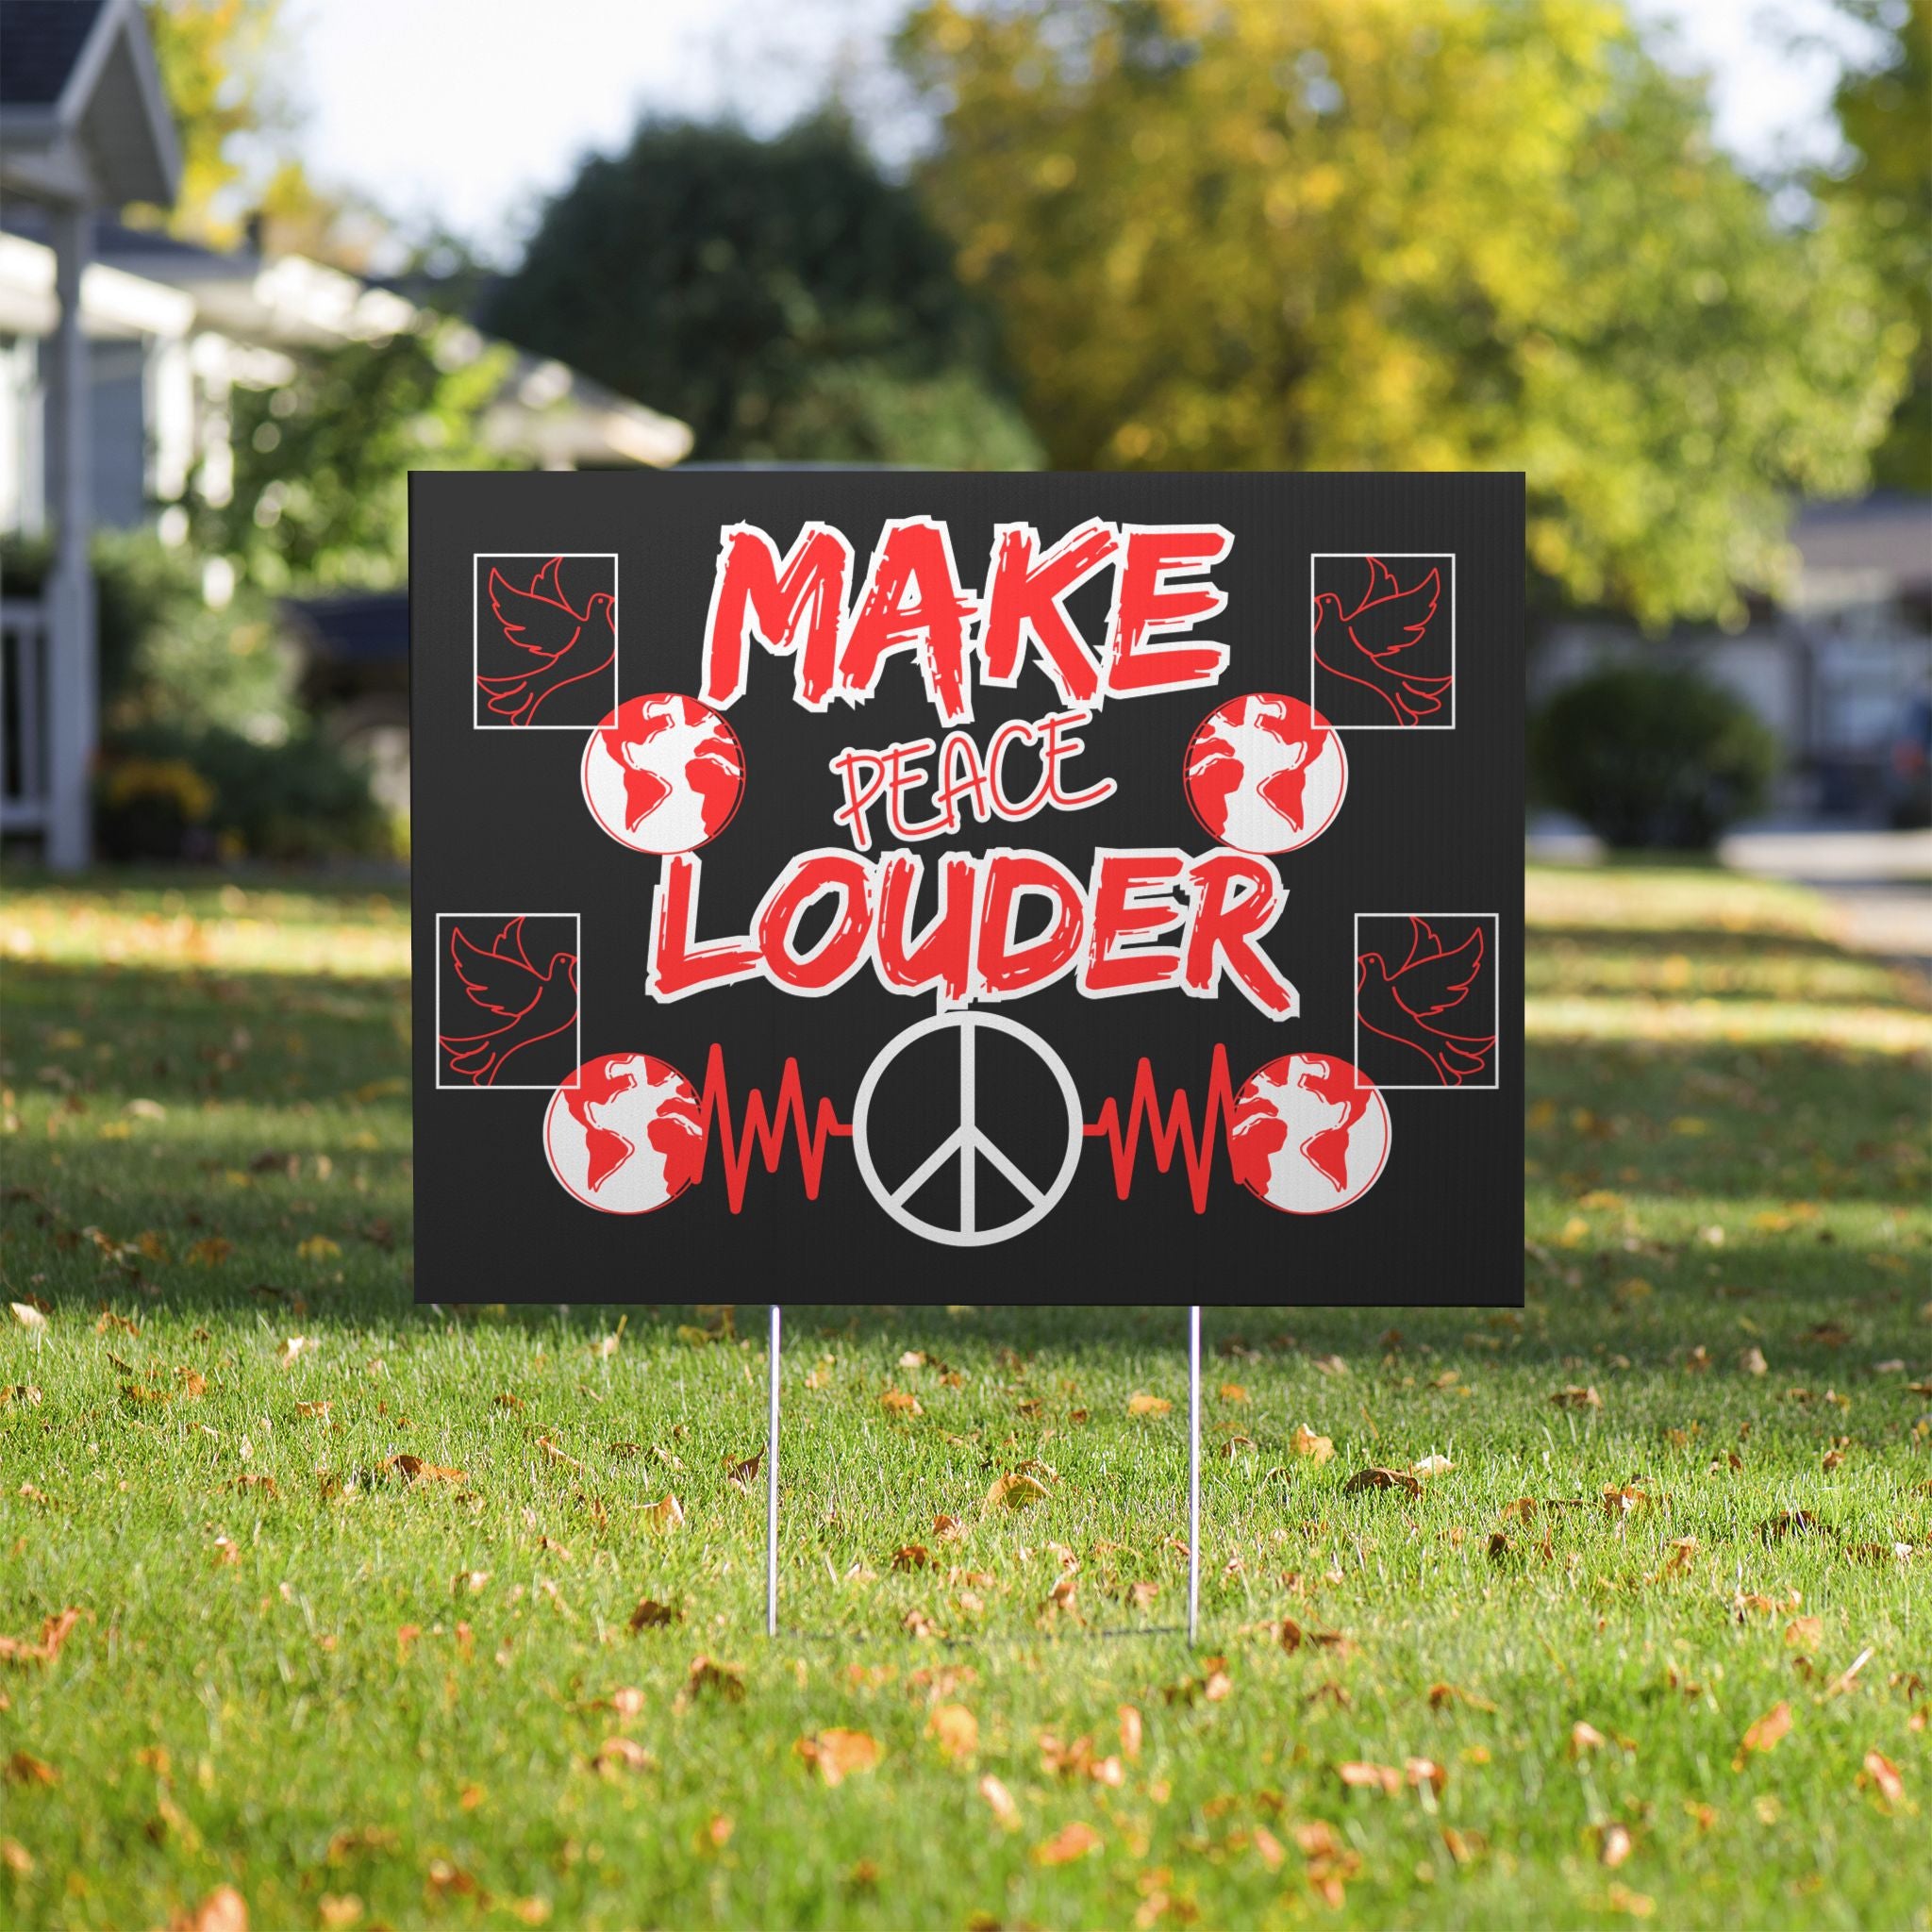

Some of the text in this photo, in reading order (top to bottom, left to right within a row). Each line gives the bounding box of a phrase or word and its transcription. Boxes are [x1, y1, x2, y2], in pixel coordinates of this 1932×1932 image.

[698, 515, 1235, 726] MAKE
[829, 708, 1118, 850] PEACE
[645, 846, 1301, 1022] LOUDER
